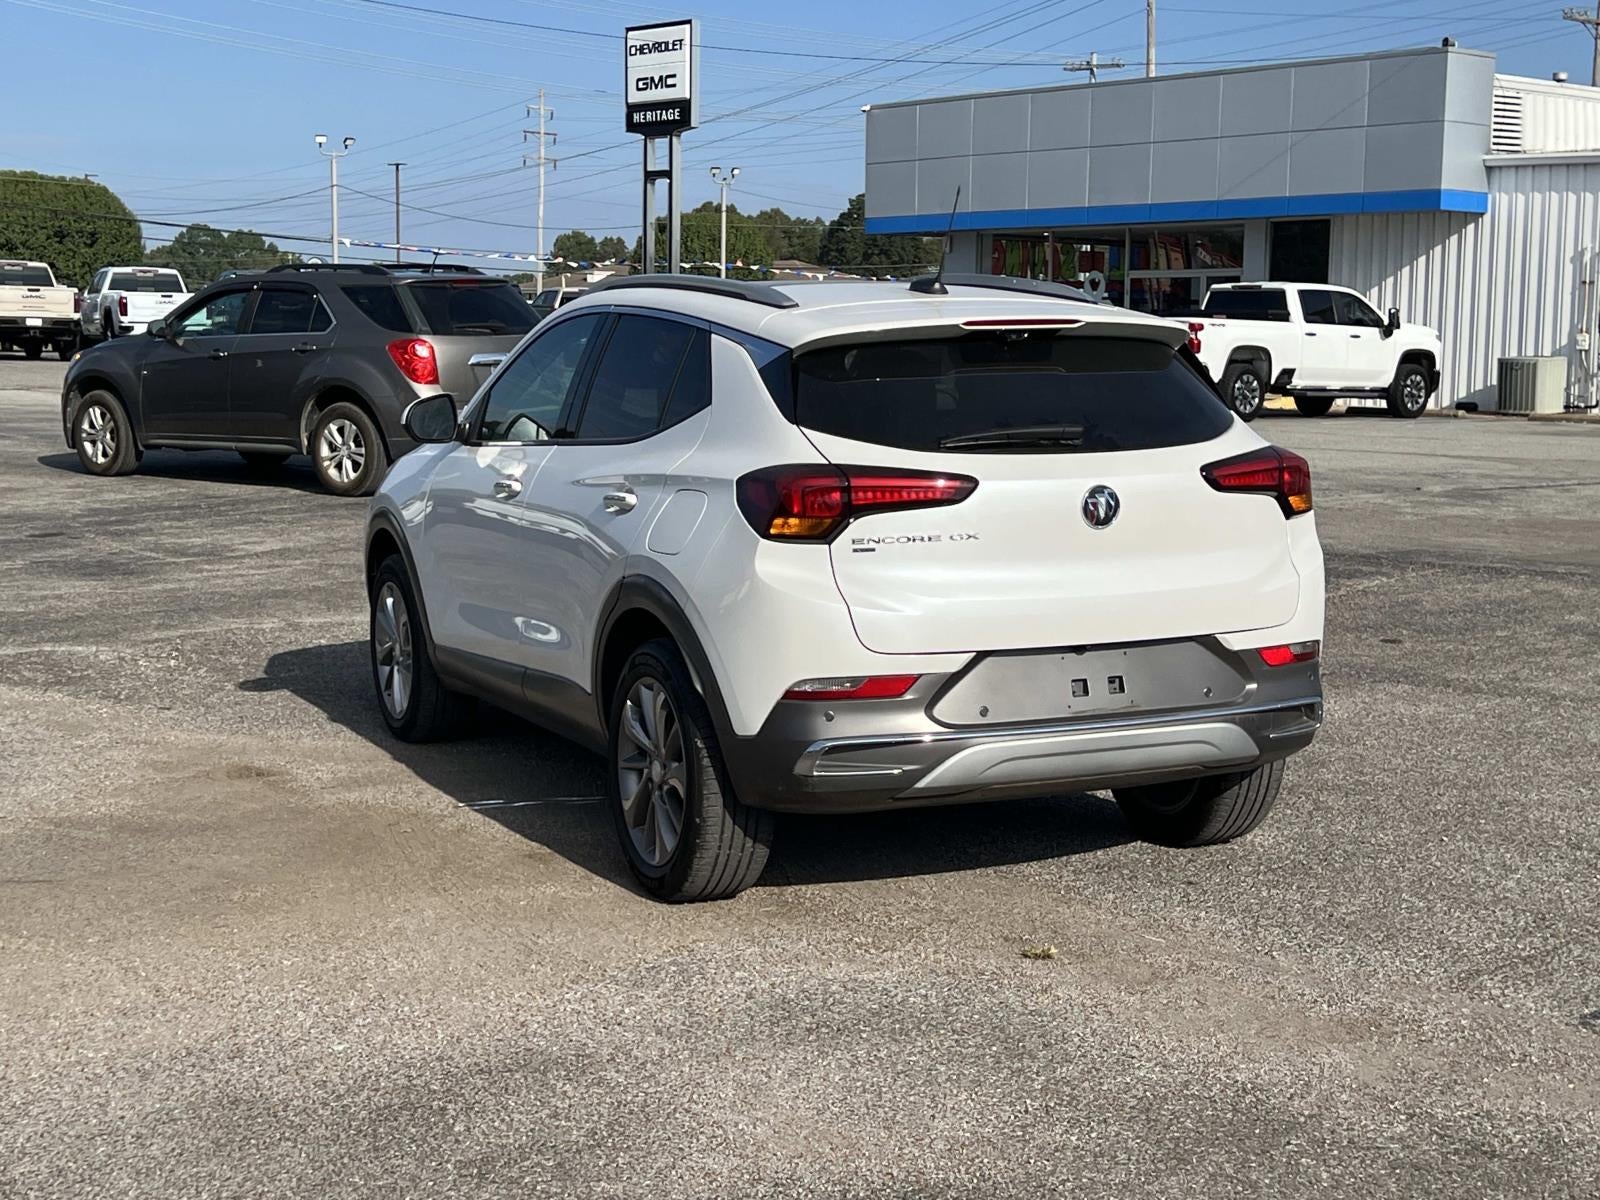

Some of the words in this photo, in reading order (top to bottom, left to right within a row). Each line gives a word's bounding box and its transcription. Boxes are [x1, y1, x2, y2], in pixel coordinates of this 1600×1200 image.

[628, 39, 685, 56] CHEVROLET
[636, 74, 677, 91] GMC
[633, 109, 681, 123] HERITAGE
[851, 534, 943, 545] ENCORE
[949, 532, 980, 541] GX
